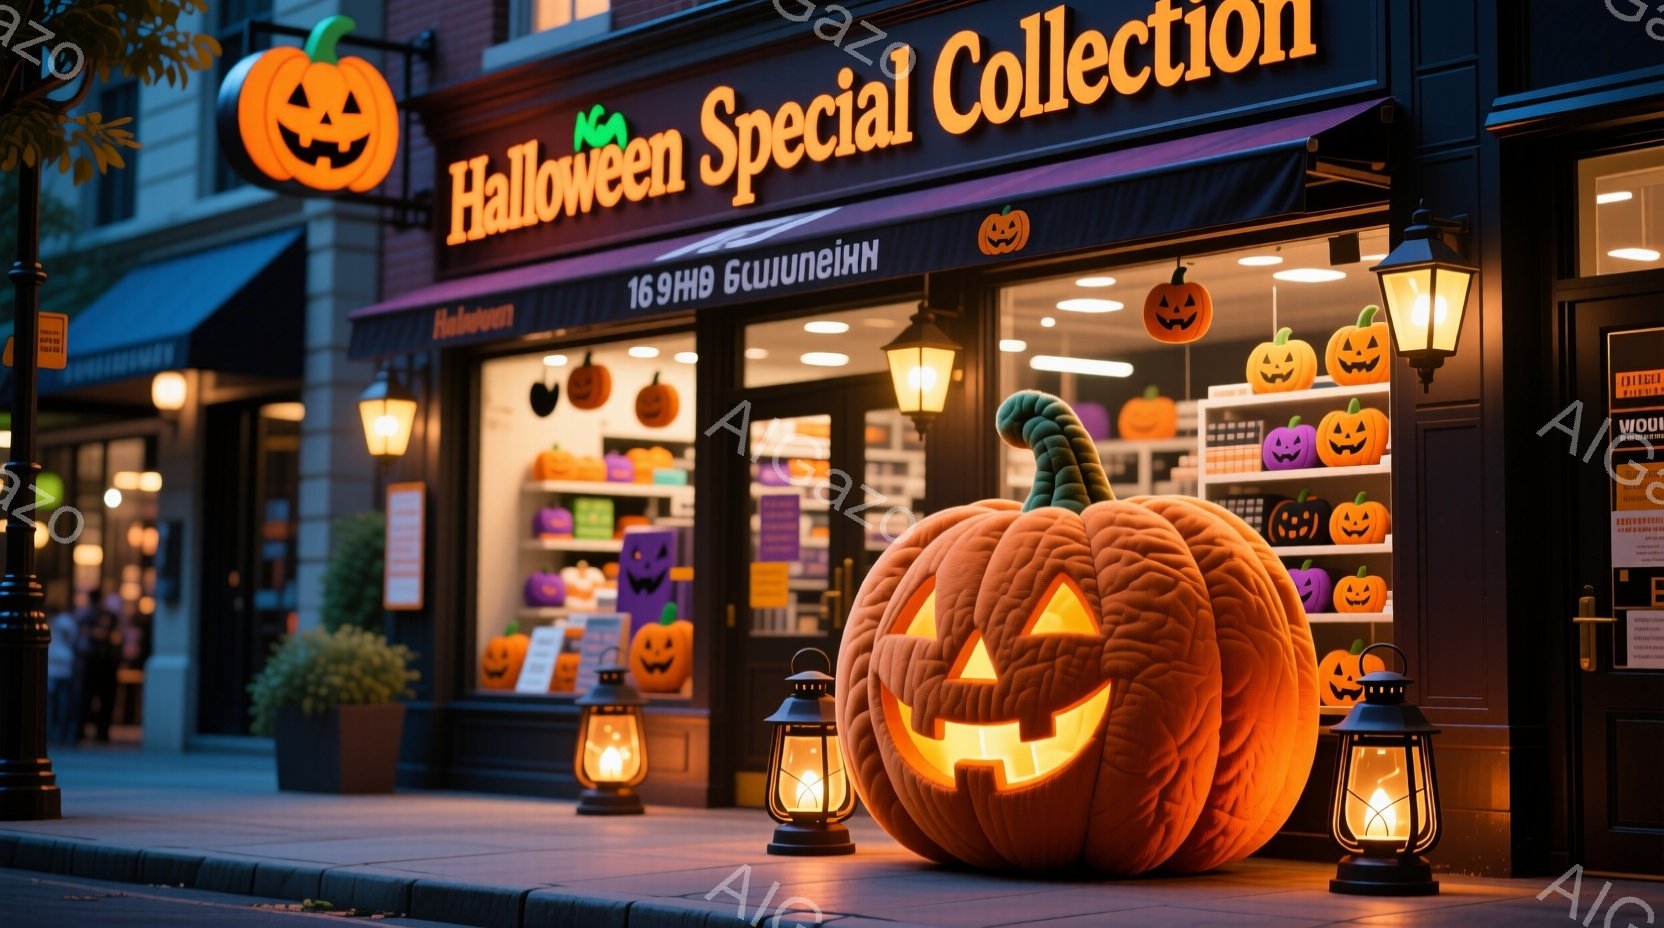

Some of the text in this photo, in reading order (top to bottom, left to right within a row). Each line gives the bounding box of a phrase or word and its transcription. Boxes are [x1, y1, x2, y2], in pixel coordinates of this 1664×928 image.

[447, 0, 1317, 245] Halloween Special Collection
